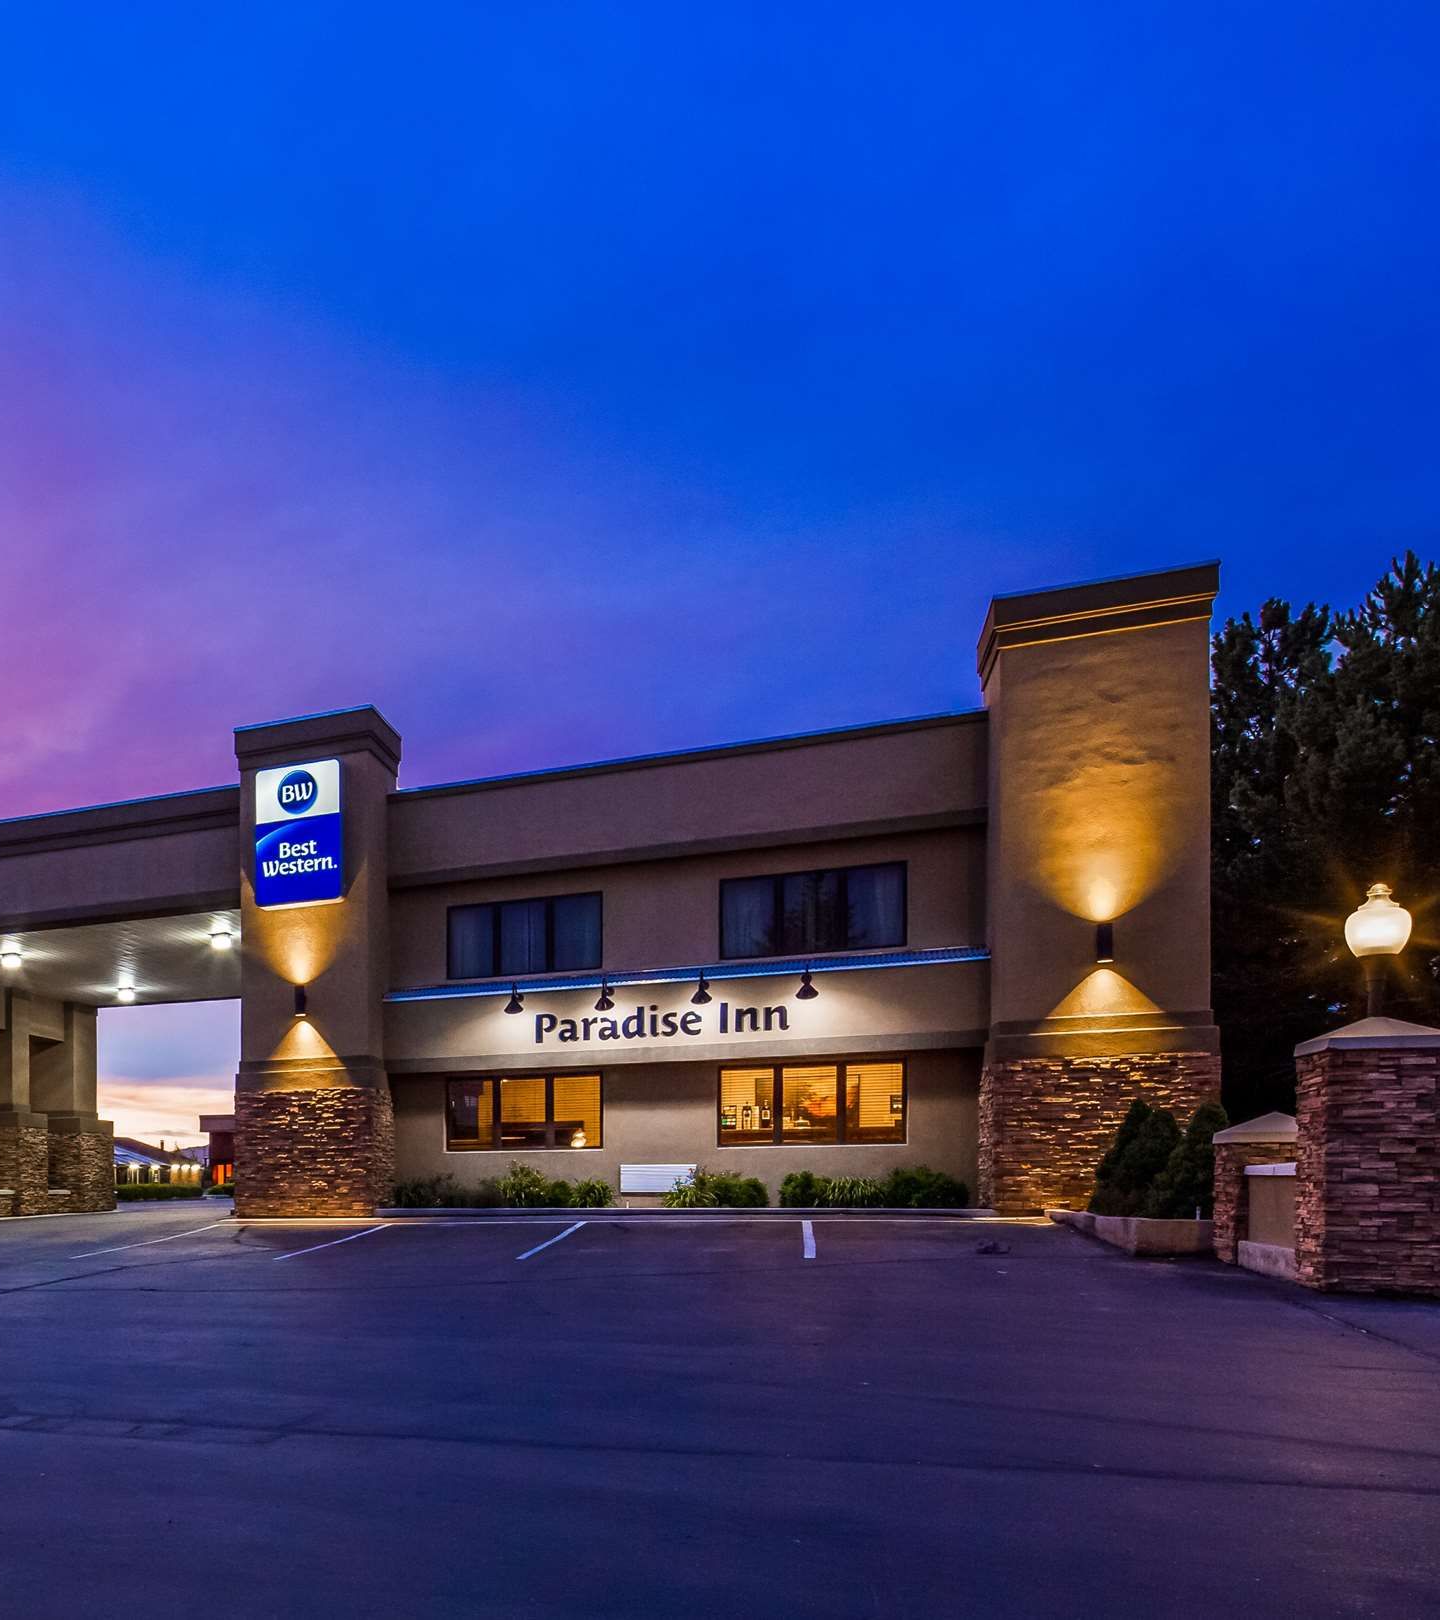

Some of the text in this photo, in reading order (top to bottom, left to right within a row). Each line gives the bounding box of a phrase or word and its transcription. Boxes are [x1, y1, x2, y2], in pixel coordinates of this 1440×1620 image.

[282, 781, 313, 803] BW
[279, 840, 317, 859] Best
[535, 1002, 790, 1044] Paradise Inn
